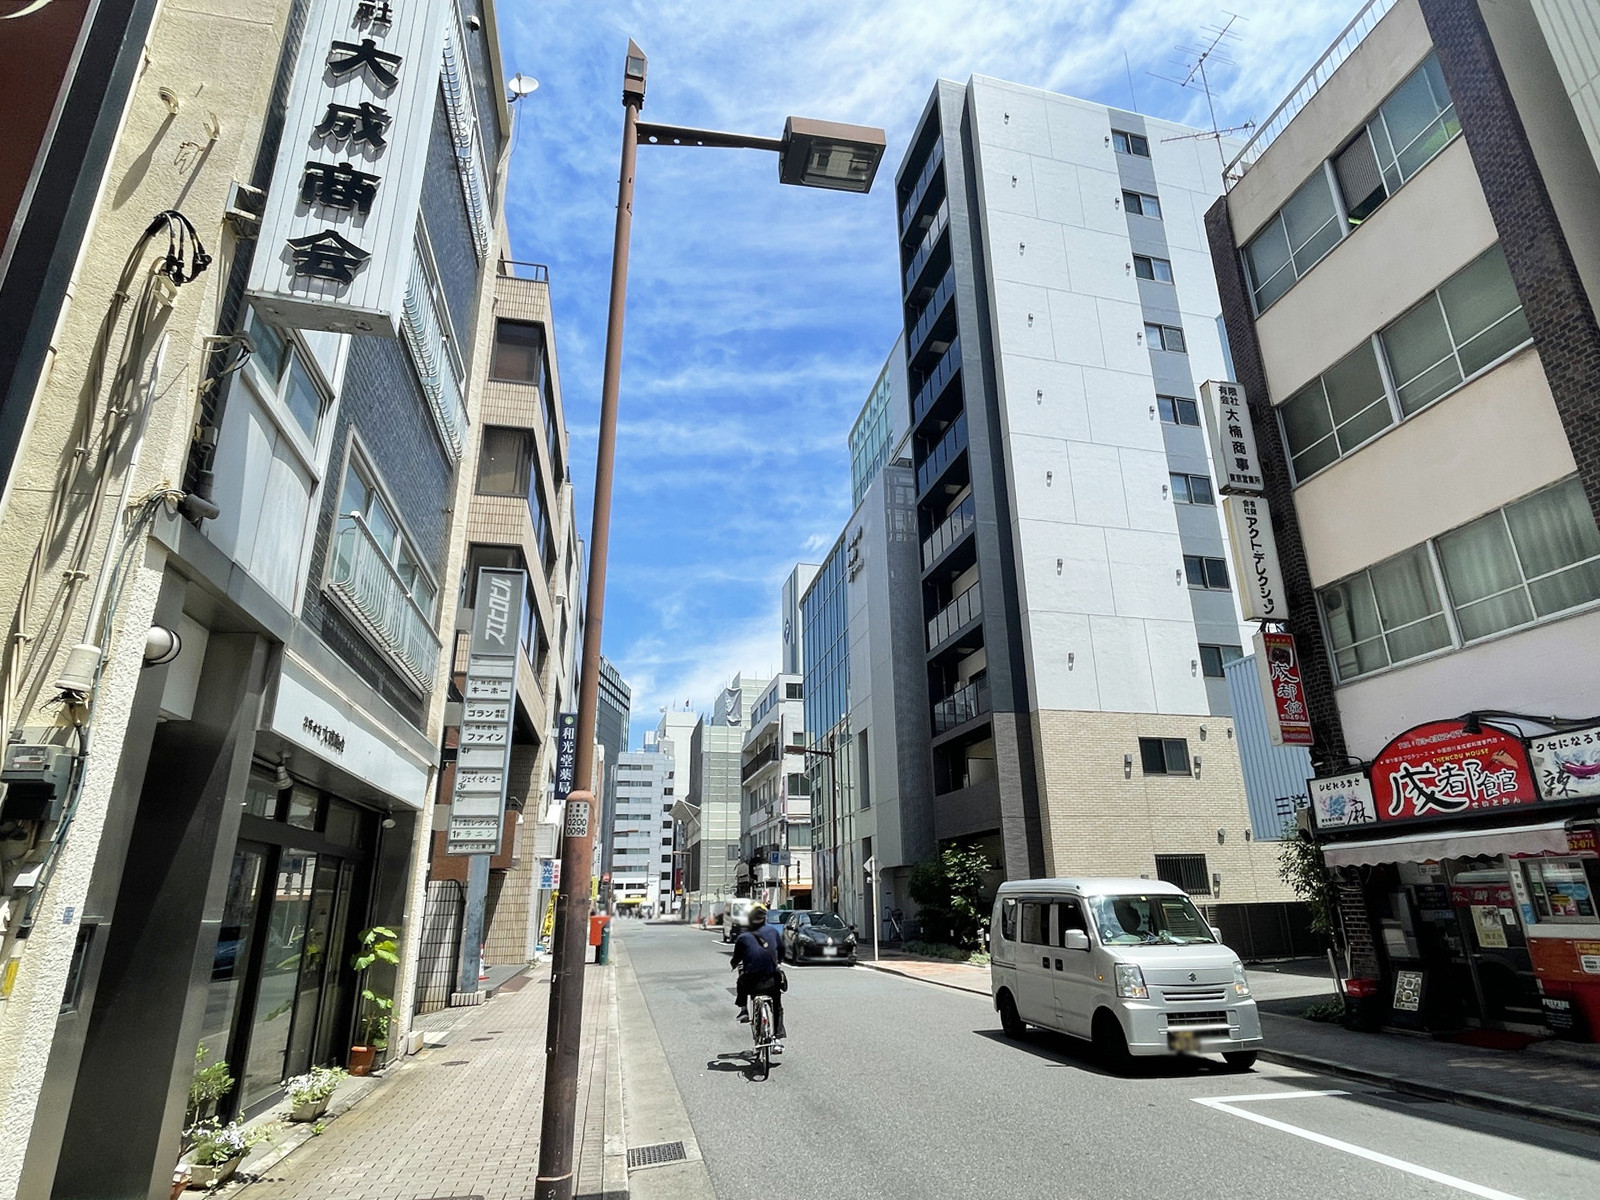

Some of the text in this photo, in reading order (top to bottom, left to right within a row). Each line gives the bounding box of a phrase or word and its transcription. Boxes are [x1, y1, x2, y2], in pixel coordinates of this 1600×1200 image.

[485, 577, 512, 645] スエヒロビル
[1270, 661, 1303, 715] 成都館
[467, 709, 494, 718] ゴラン
[467, 733, 504, 742] ファイン
[558, 727, 575, 795] 和光堂薬局
[1390, 761, 1516, 816] 成都館
[567, 827, 586, 836] 0096
[568, 818, 587, 826] 0200
